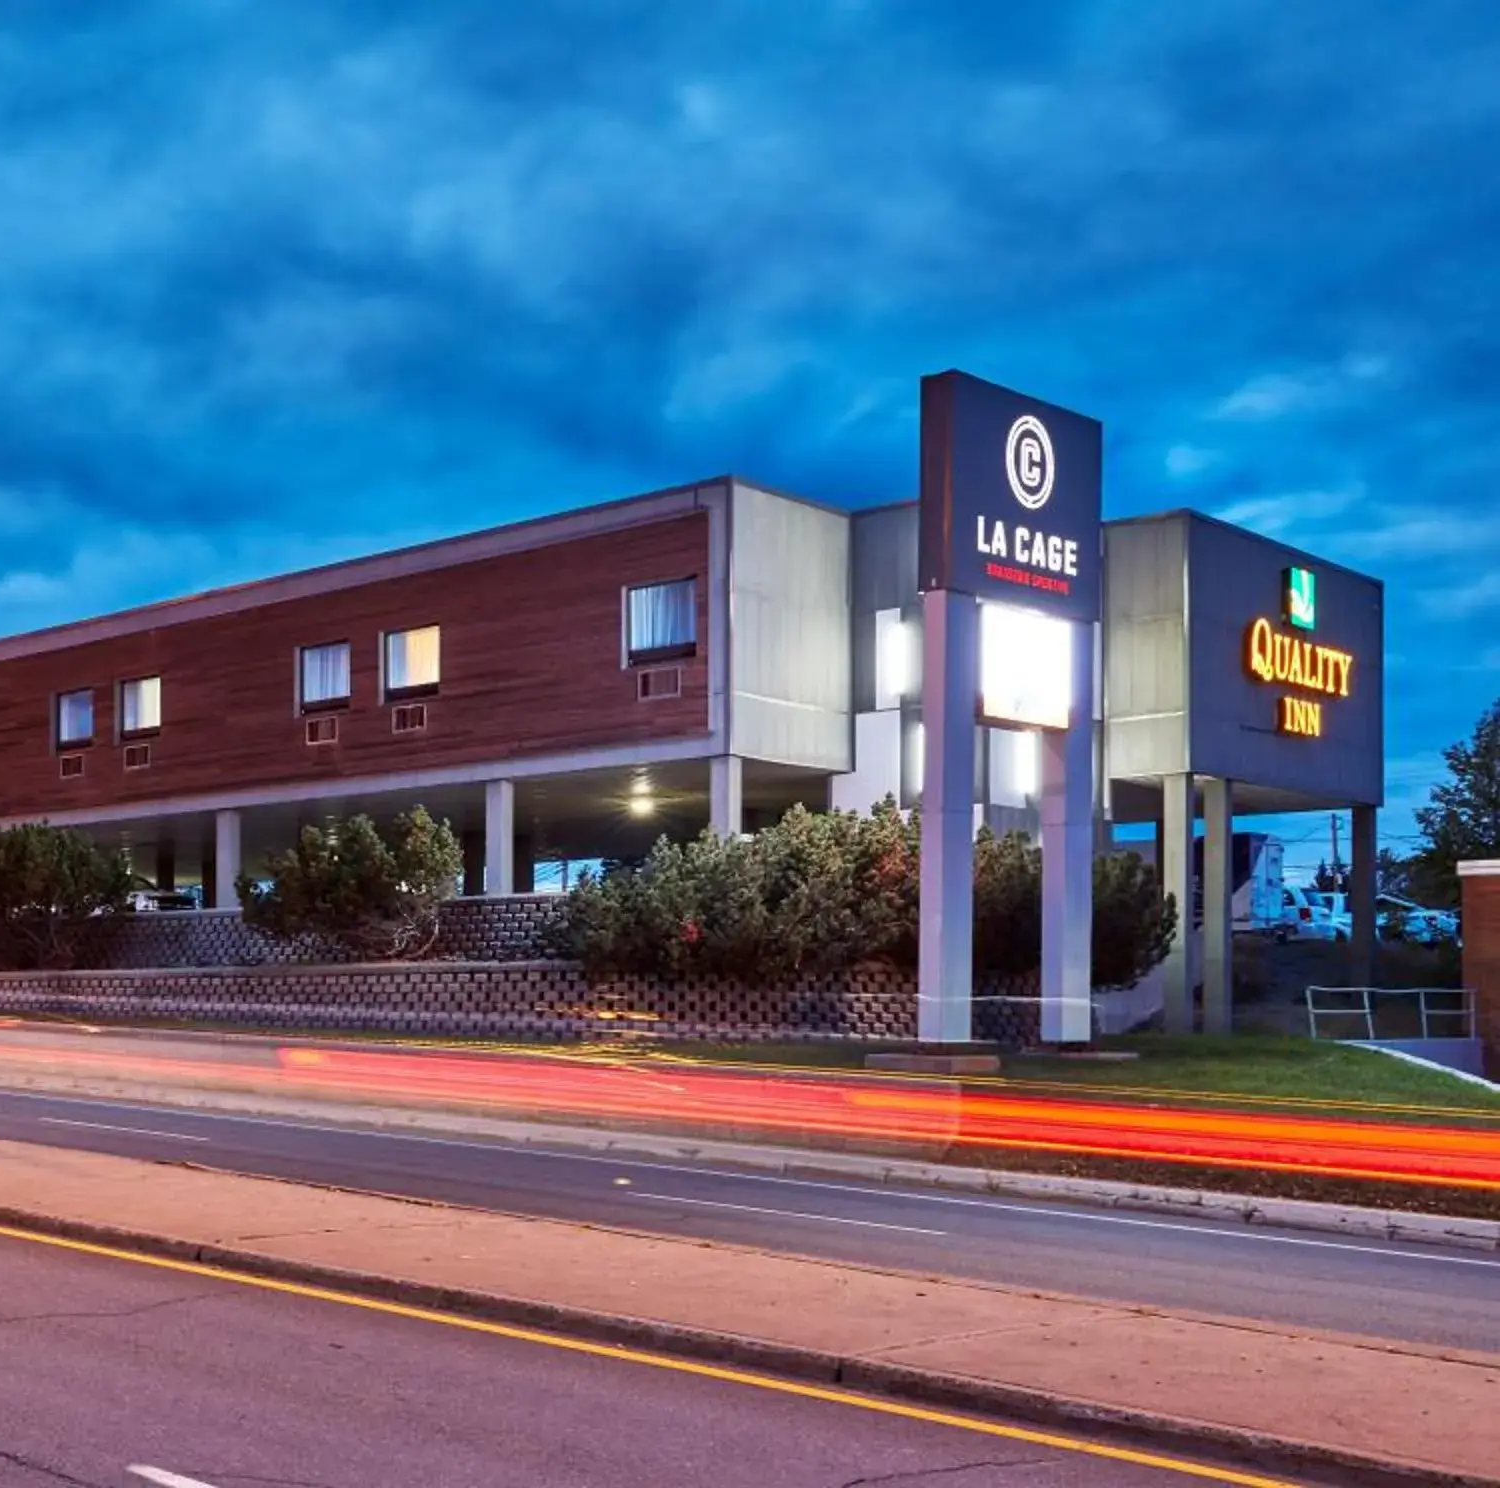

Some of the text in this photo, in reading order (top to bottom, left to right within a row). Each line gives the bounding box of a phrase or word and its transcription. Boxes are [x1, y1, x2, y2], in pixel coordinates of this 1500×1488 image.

[1020, 437, 1041, 487] C
[977, 515, 1078, 577] LA CAGE
[1250, 617, 1353, 697] QUALITY
[1283, 697, 1321, 737] INN
